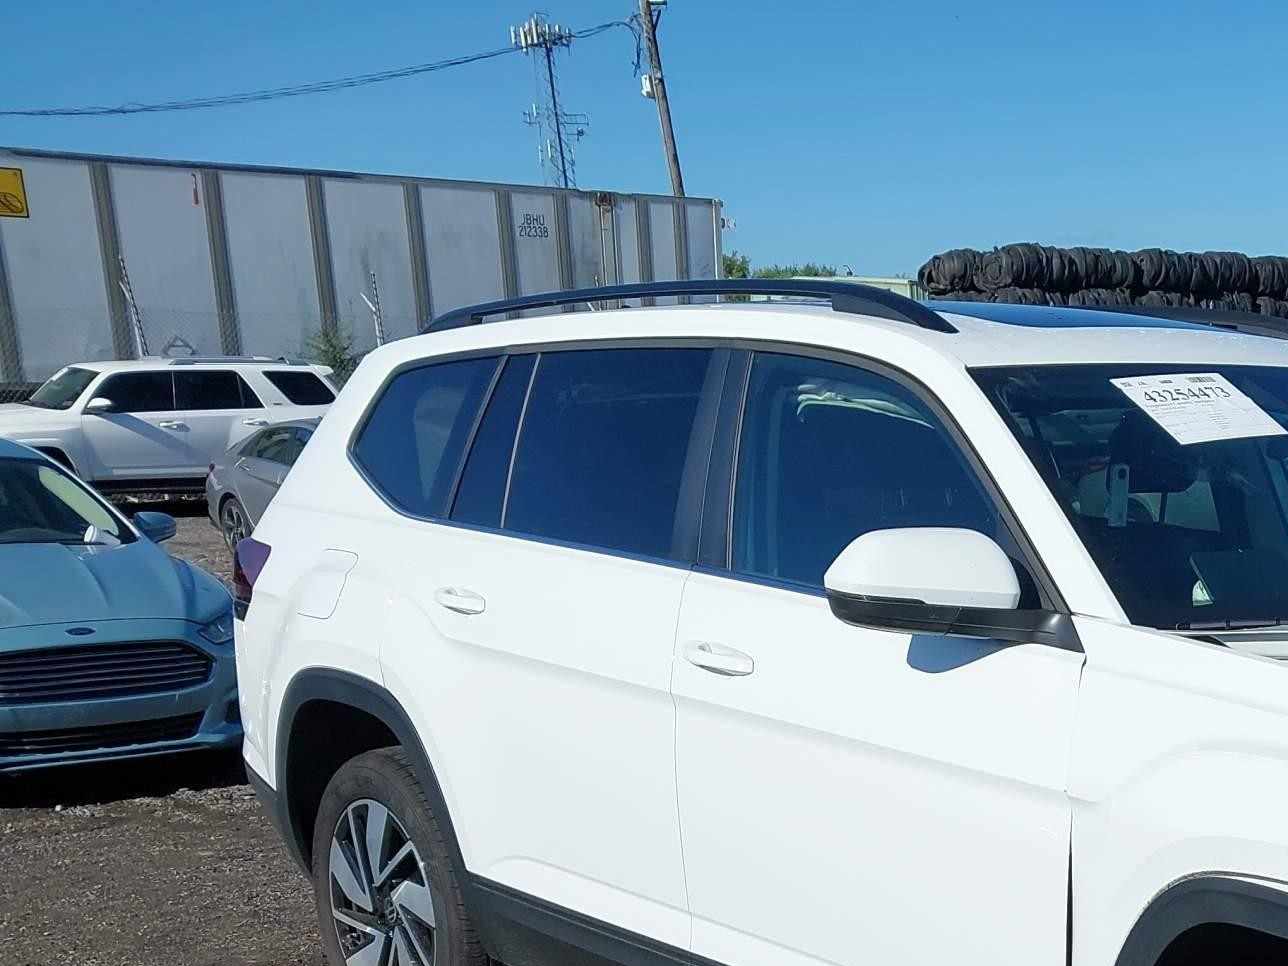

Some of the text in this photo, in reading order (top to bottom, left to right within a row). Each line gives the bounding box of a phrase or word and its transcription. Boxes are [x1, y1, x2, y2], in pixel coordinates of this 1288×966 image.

[521, 213, 545, 226] JBHU
[518, 225, 549, 238] 212338
[1144, 386, 1231, 402] 43254473
